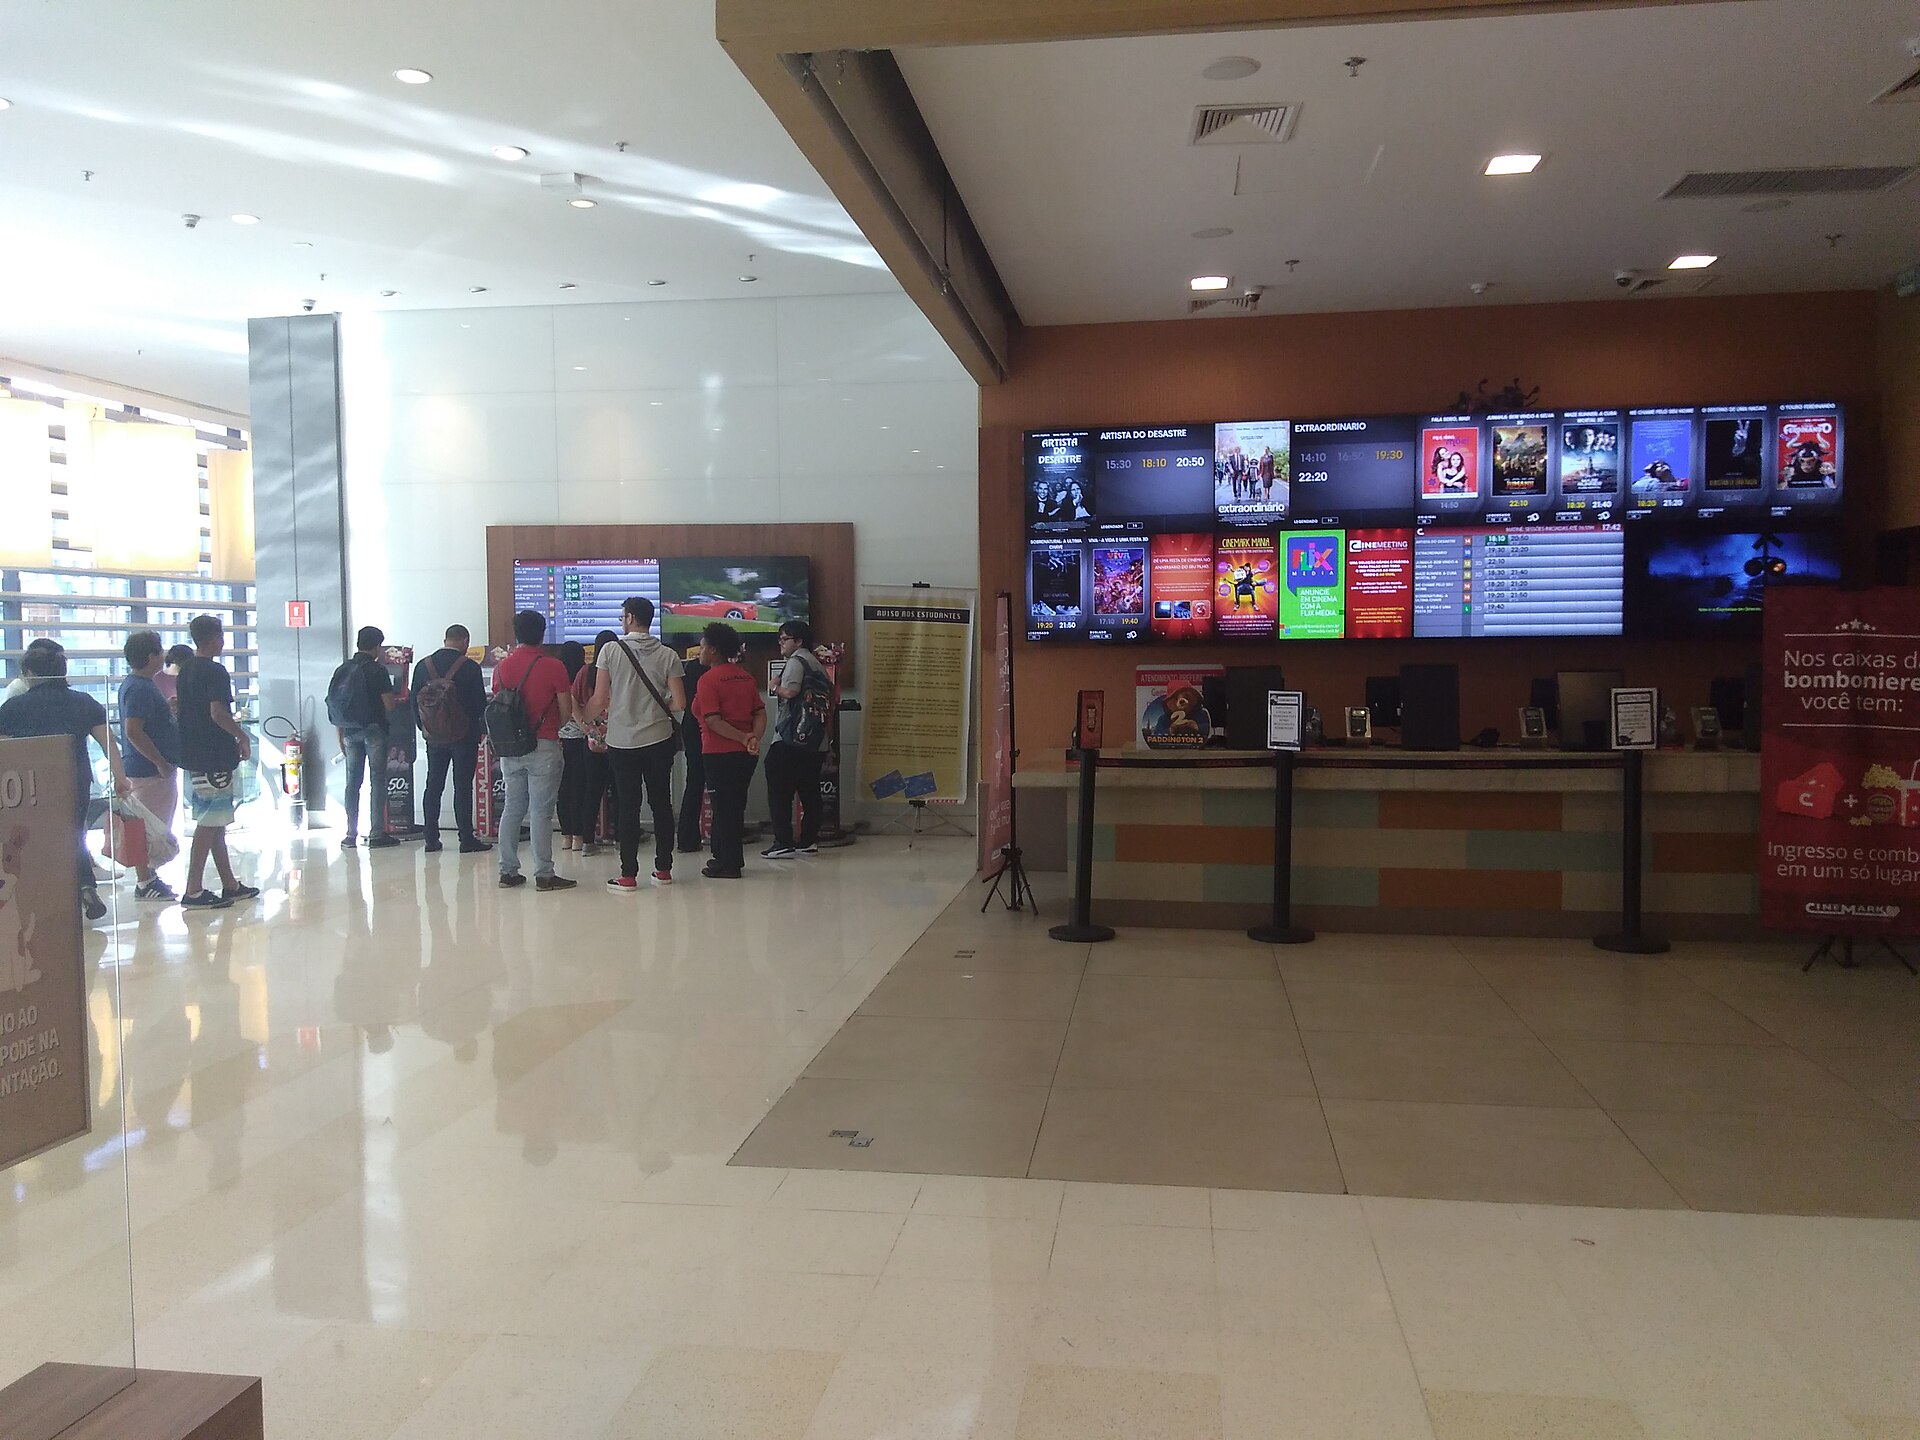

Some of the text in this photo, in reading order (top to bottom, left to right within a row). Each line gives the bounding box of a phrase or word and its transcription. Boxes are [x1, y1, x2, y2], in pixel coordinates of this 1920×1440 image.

[1100, 429, 1187, 440] ARTISTA DO DESASTRE
[1042, 438, 1078, 448] ARTISTA
[1054, 447, 1066, 455] DO
[1300, 452, 1326, 462] 14:10
[1375, 450, 1403, 460] 19:30
[1039, 455, 1082, 465] DESASTRE
[1106, 457, 1204, 469] 15:30 18:10 20:50
[1298, 472, 1328, 482] 22:20
[1218, 502, 1285, 513] extraordinário
[1509, 500, 1529, 508] 22:10
[1222, 537, 1270, 548] CINEMARK MANIA
[917, 610, 961, 621] ESTUDANTES
[1784, 650, 1920, 669] Nos caixas d
[1784, 670, 1920, 691] bomboniere
[1801, 692, 1903, 712] você tem:
[1147, 736, 1197, 744] PADDINGTON
[0, 768, 38, 810] O!
[1768, 842, 1920, 864] Ingresso e comb
[1777, 863, 1806, 876] em
[1813, 866, 1843, 878] um
[1850, 863, 1870, 880] só
[1806, 902, 1890, 917] CINEMARK
[18, 1005, 38, 1030] AO
[40, 1027, 60, 1052] NA
